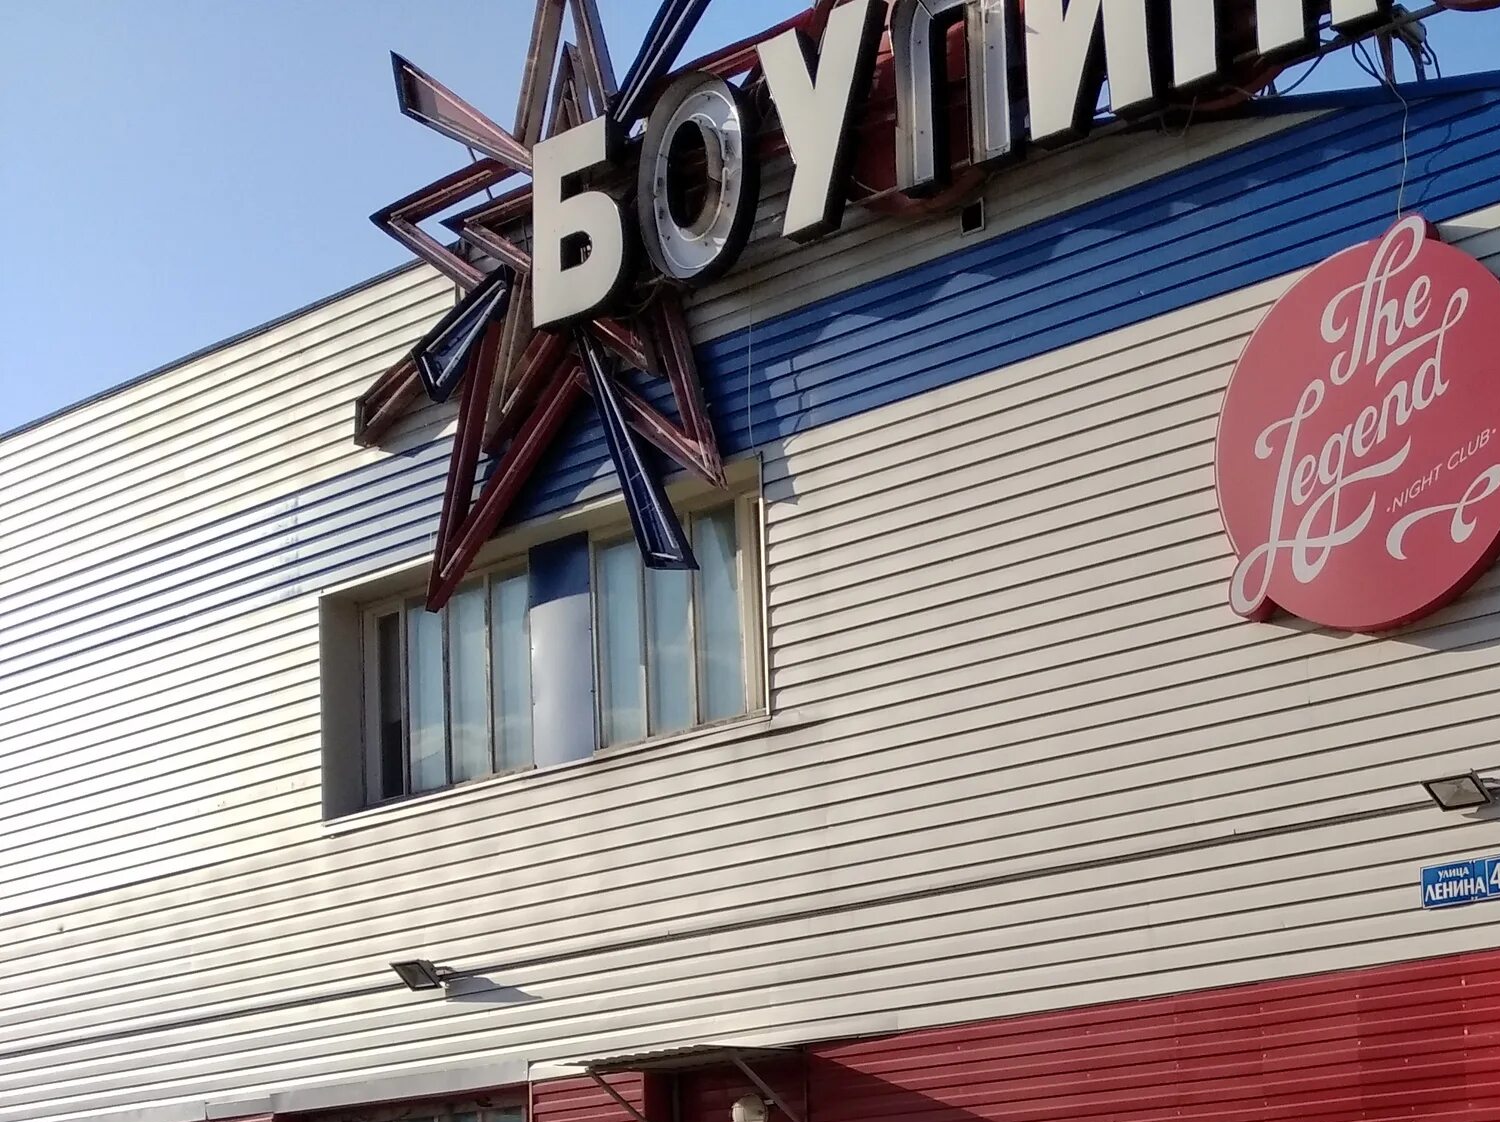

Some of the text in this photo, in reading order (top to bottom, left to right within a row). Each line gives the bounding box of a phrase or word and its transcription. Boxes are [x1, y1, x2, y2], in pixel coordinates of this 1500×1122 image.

[532, 0, 1386, 329] БОУЛИ
[1320, 215, 1432, 386] The
[1229, 287, 1469, 615] Legend
[1425, 876, 1486, 902] ЛЕНИНА
[1437, 866, 1470, 882] УЛИЦА
